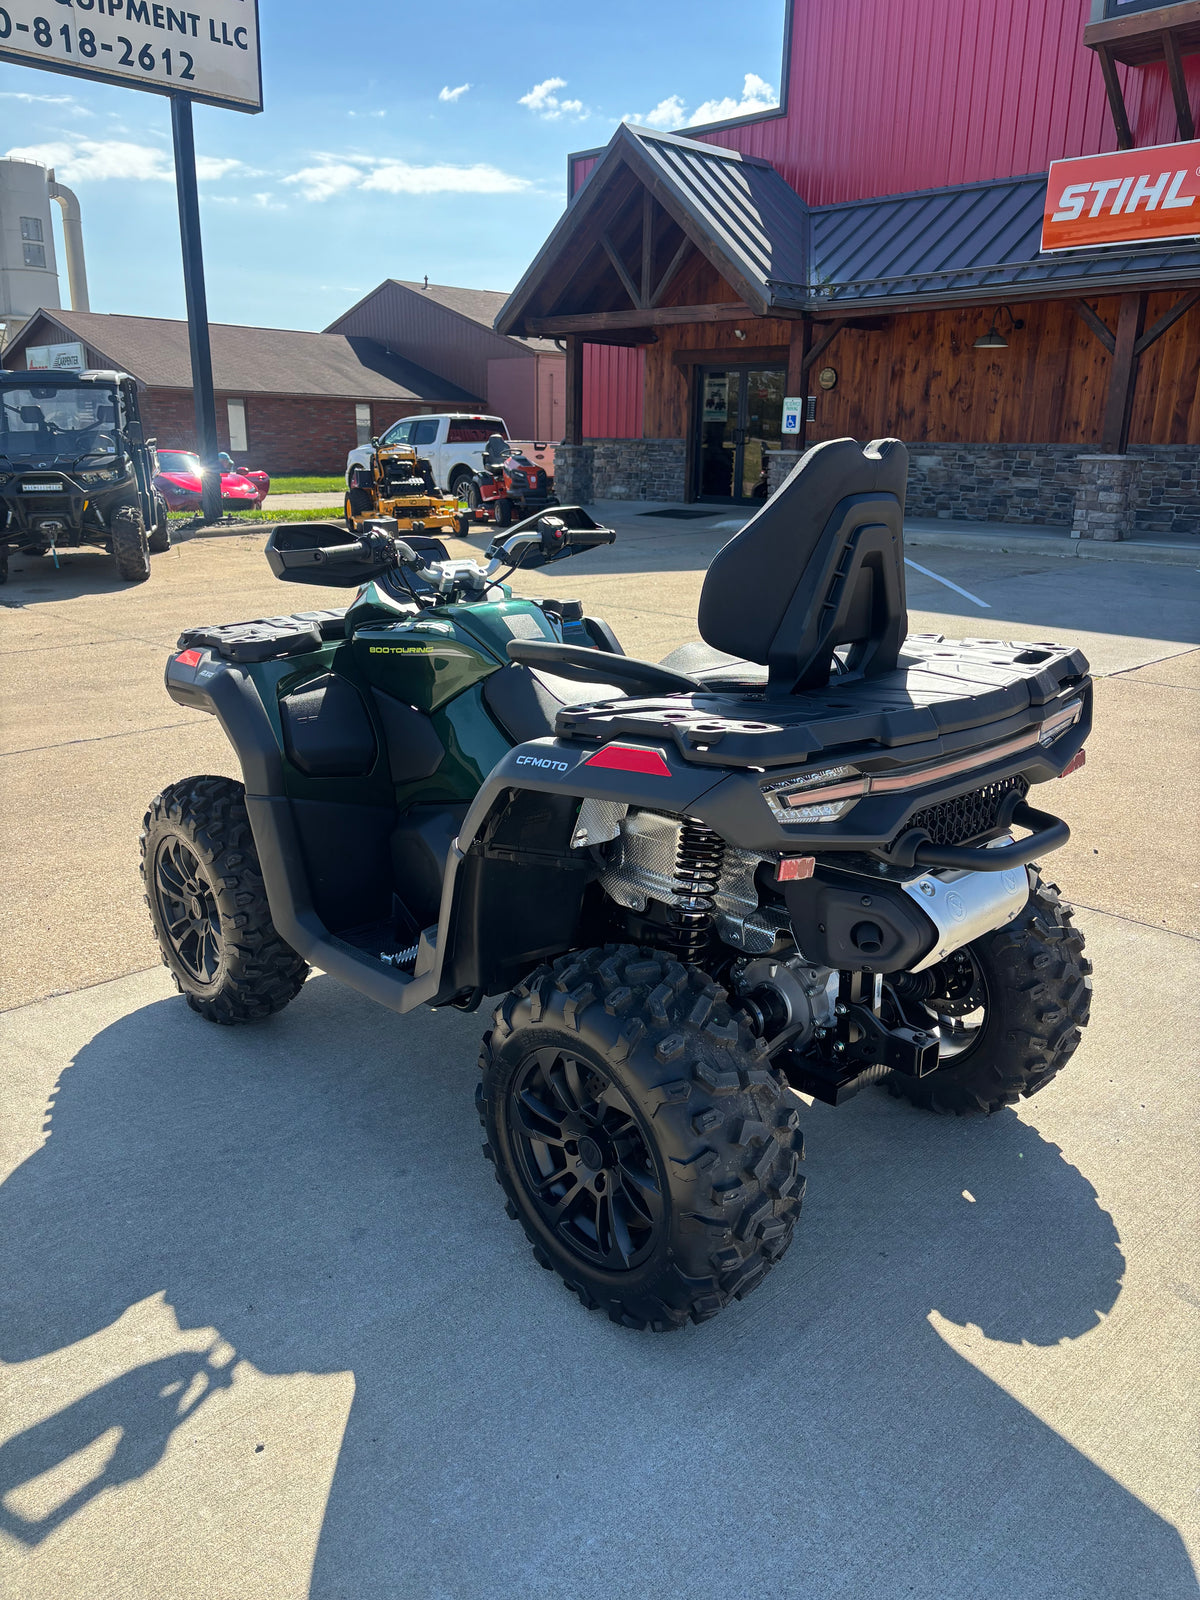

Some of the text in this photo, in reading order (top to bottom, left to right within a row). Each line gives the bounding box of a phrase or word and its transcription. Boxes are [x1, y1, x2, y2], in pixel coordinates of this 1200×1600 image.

[55, 0, 248, 50] IPMENT LLC
[1051, 169, 1196, 222] STIHL
[516, 755, 569, 772] CFMOTO
